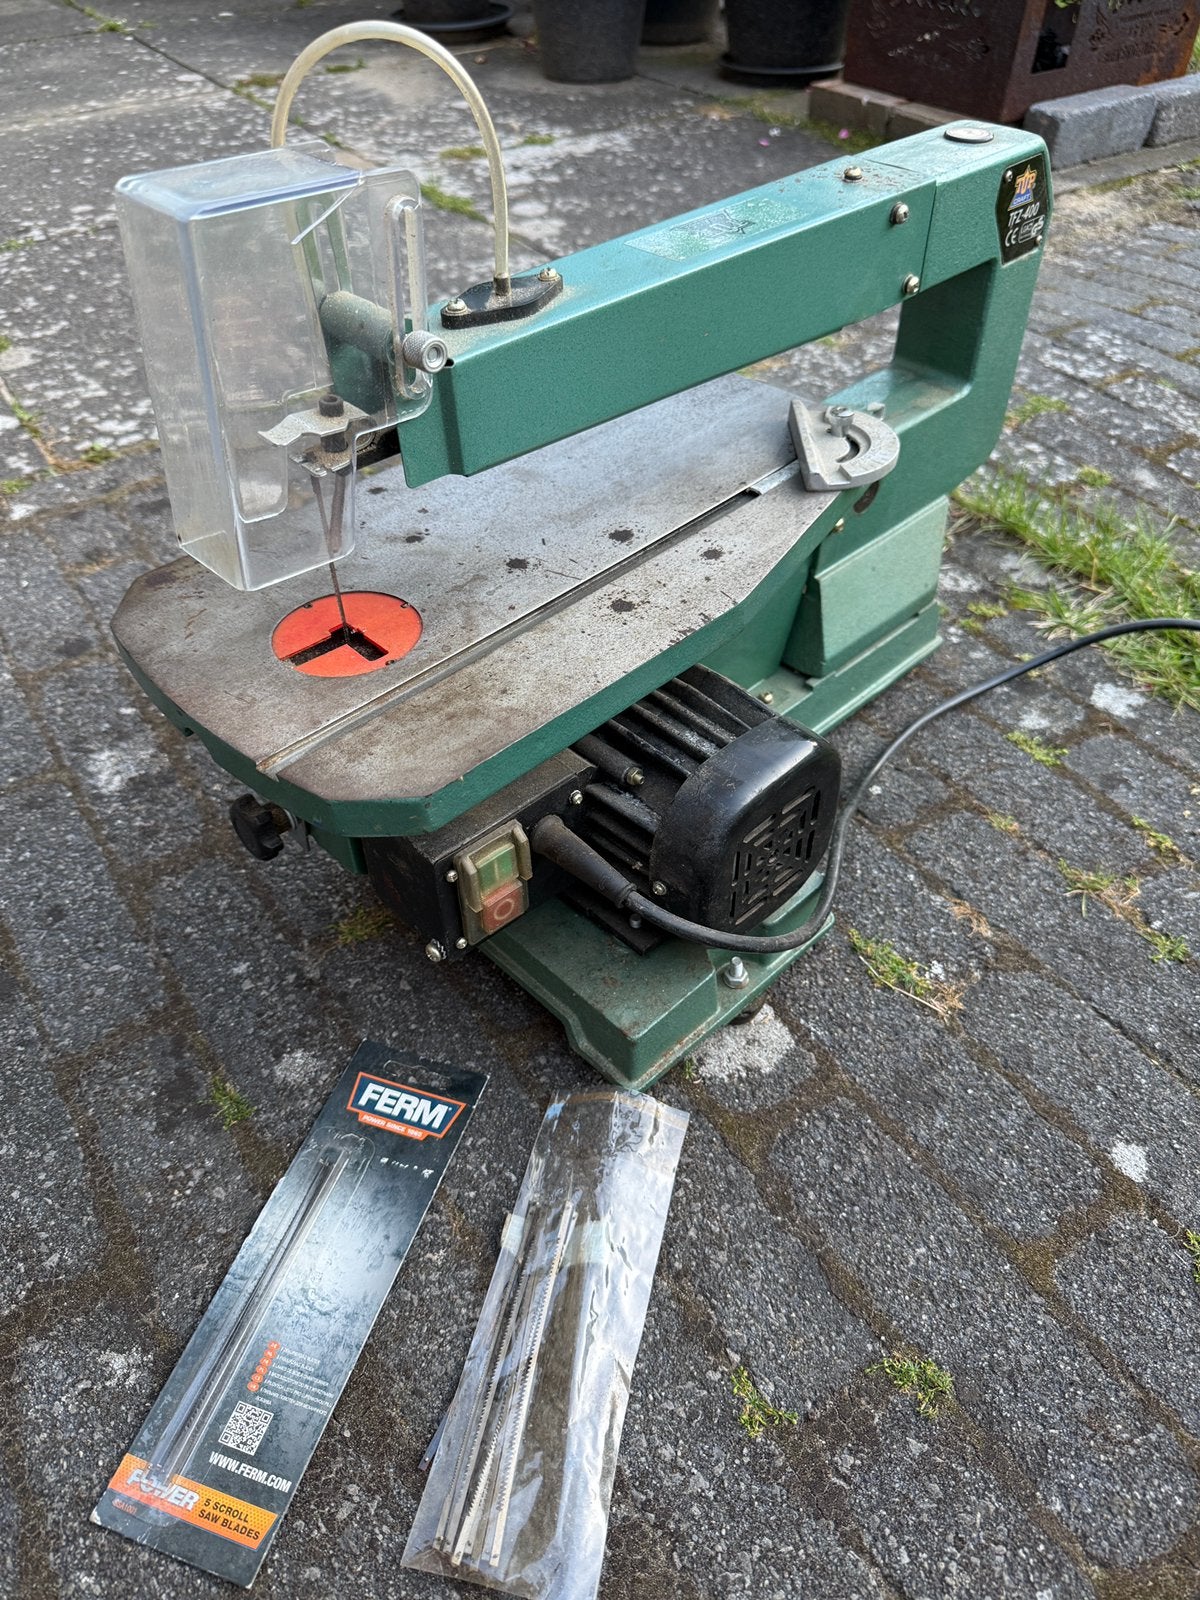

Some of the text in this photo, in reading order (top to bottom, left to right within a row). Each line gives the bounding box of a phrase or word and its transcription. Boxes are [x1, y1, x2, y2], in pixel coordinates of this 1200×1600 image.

[1008, 202, 1040, 227] TFZ-400
[358, 1082, 449, 1130] FERM
[362, 1114, 386, 1126] POWER
[208, 1451, 292, 1493] WWW.FERM.COM
[126, 1468, 200, 1511] POWER
[198, 1509, 261, 1541] SAW BLADES
[203, 1498, 249, 1523] 5 SCROLL
